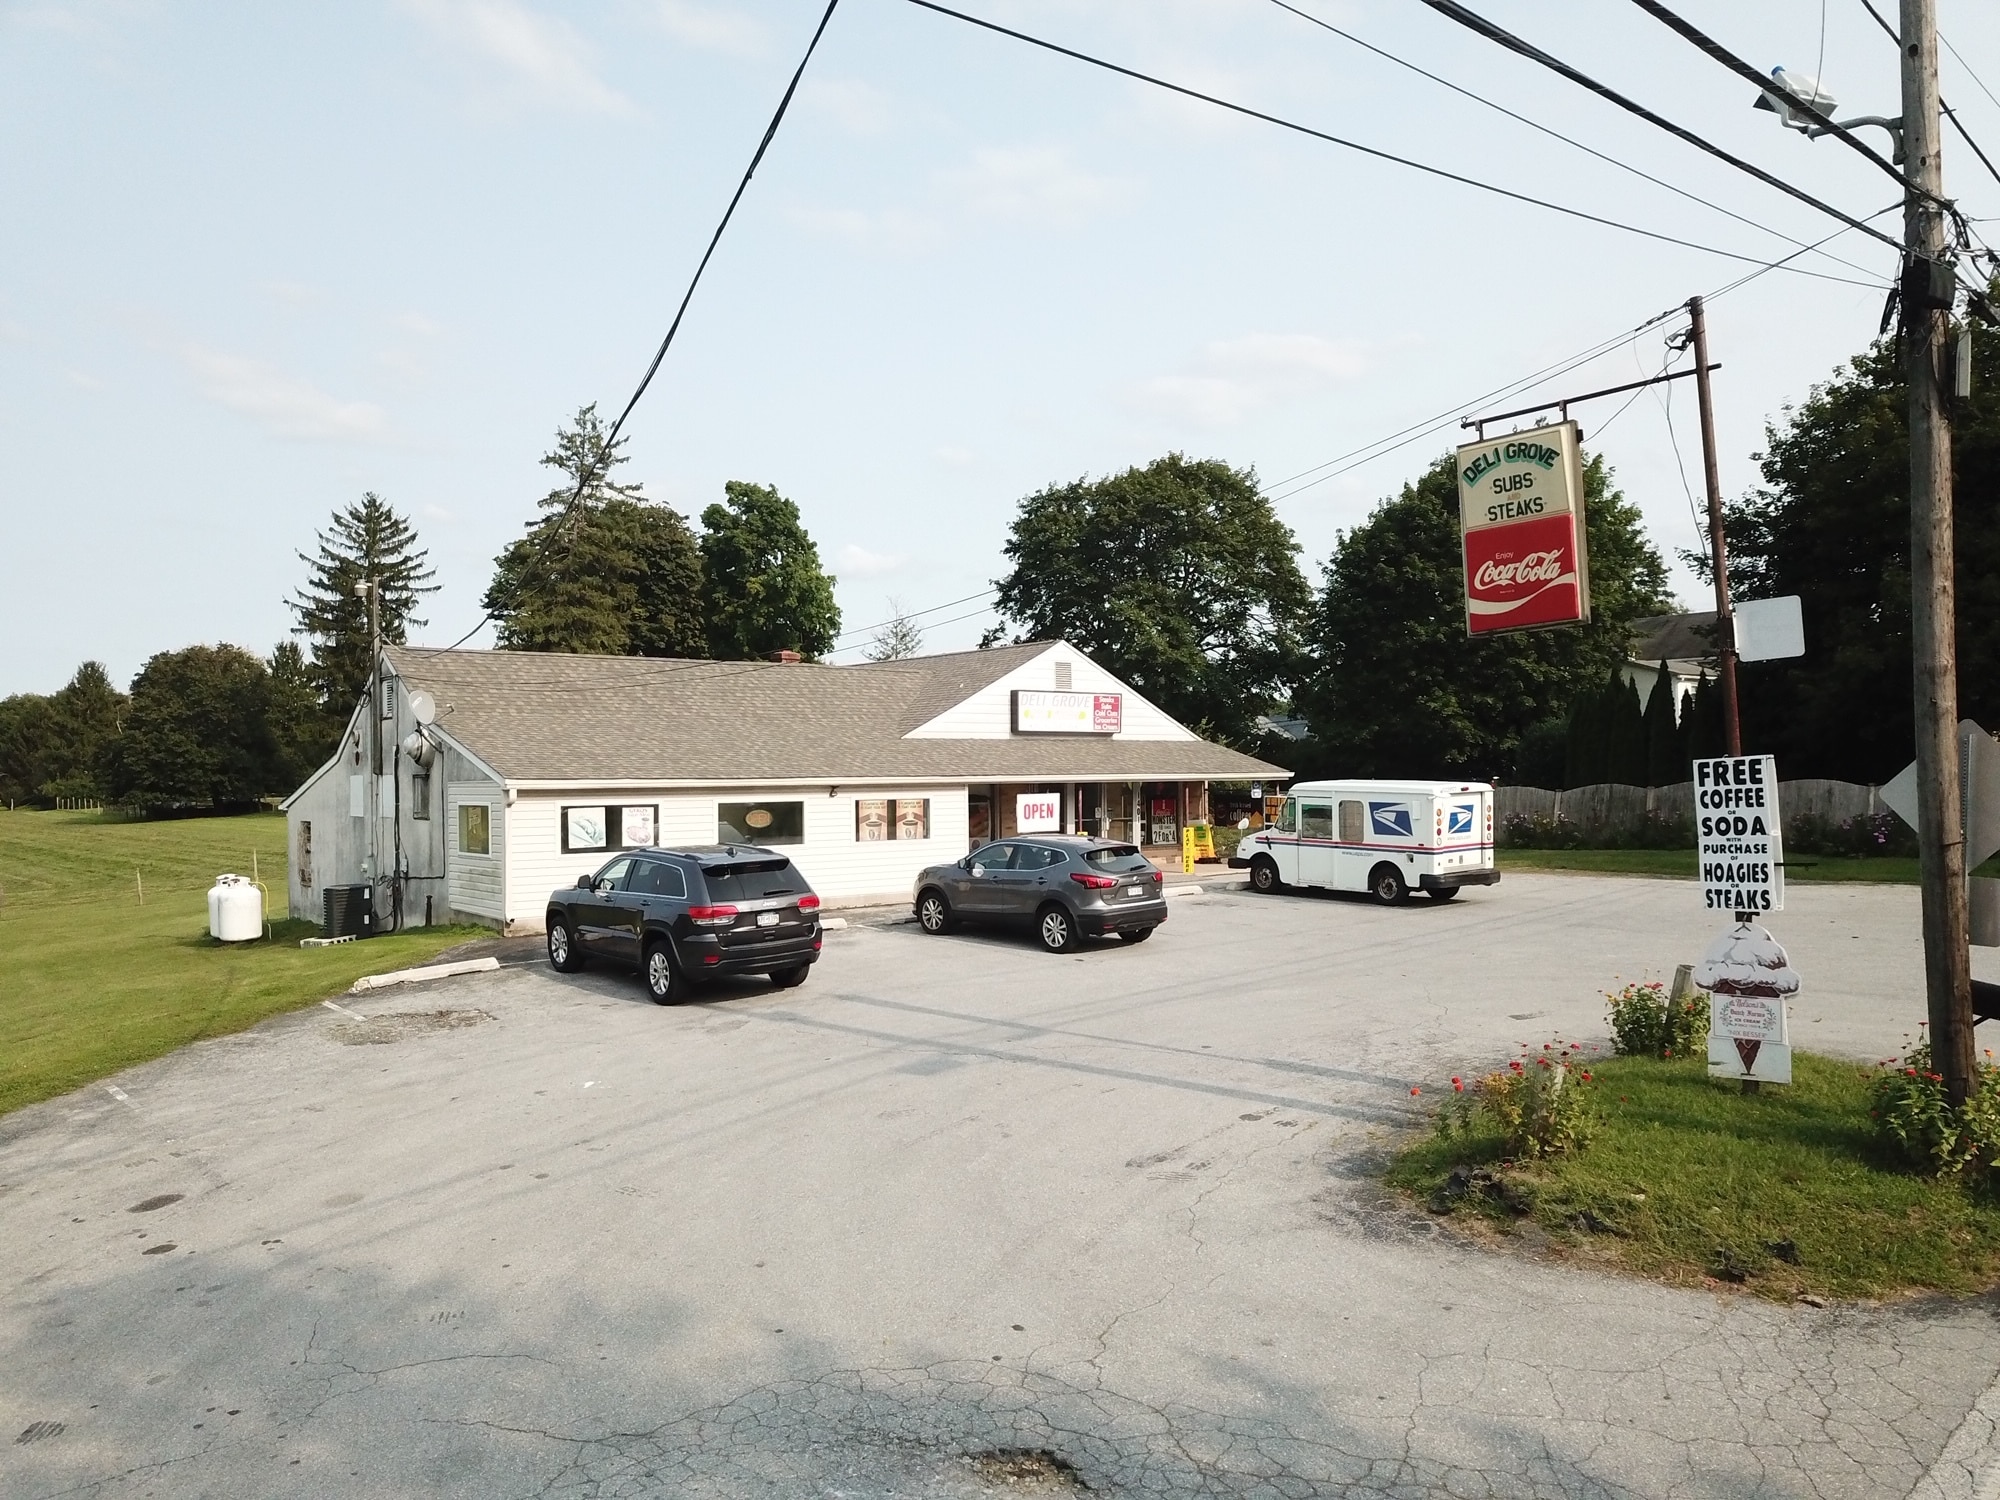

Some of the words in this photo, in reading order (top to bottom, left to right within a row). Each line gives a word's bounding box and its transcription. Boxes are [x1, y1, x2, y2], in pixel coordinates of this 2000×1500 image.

[1463, 447, 1501, 487] DELI
[1503, 442, 1560, 470] GROVE
[1492, 472, 1534, 494] SUBS
[1487, 497, 1545, 521] STEAKS
[1495, 552, 1514, 561] Enjoy
[1474, 547, 1564, 590] Coca-Cola
[1020, 694, 1046, 706] DELI
[1052, 695, 1091, 708] GROVE
[1697, 759, 1763, 787] FREE
[1700, 788, 1765, 809] COFFEE
[1023, 803, 1054, 820] OPEN
[1701, 816, 1767, 836] SODA
[1703, 844, 1768, 854] PURCHASE
[1704, 863, 1769, 883] HOAGIES
[1705, 889, 1771, 910] STEAKS
